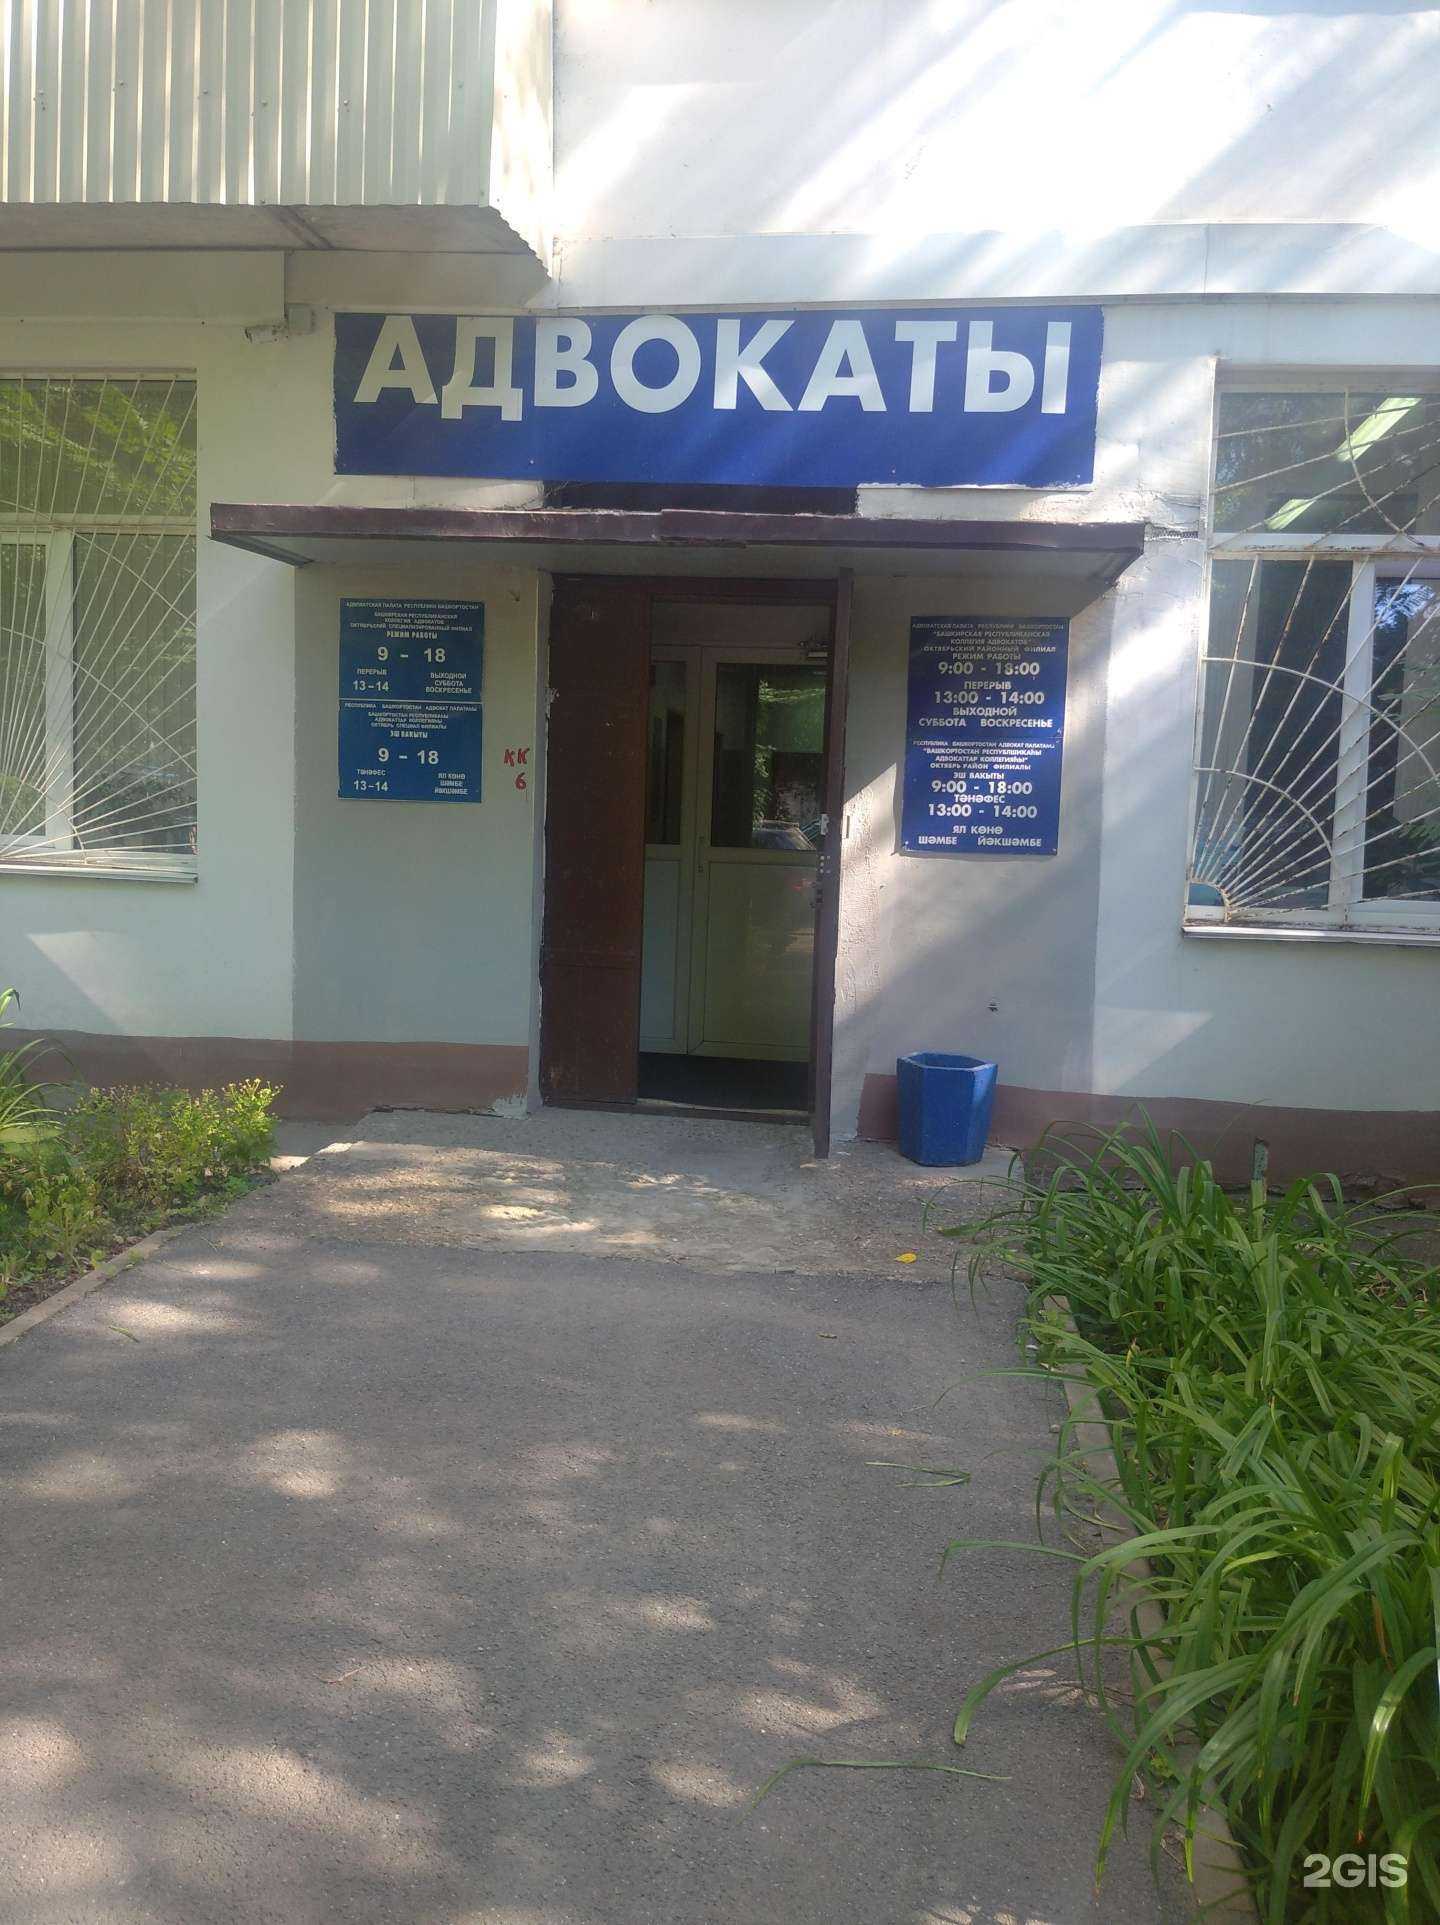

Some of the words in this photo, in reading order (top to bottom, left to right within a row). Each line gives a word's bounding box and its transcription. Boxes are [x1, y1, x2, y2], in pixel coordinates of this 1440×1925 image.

[352, 314, 1072, 421] АДВОКАТЫ
[377, 646, 389, 661] 9
[424, 648, 446, 662] 18
[938, 661, 973, 675] 9:00
[996, 663, 1040, 675] 18:00
[426, 686, 472, 694] ВОСКРЕСЕНЬЕ
[964, 682, 1012, 690] ПЕРЕРЫВ
[935, 691, 978, 704] 13:00
[1001, 692, 1044, 704] 14:00
[953, 706, 1017, 716] ВЫХОДНОЙ
[919, 718, 966, 727] СУББОТА
[980, 719, 1053, 728] ВОСКРЕСЕНЬЕ
[378, 747, 389, 762] 9
[417, 750, 439, 765] 18
[515, 772, 527, 790] 6
[931, 780, 966, 792] 9:00
[989, 782, 1032, 794] 18:00
[954, 795, 1005, 803] ТӘНӘФЕС
[929, 804, 971, 816] 13:00
[994, 805, 1037, 818] 14:00
[952, 825, 966, 834] ЯЛ
[919, 836, 958, 845] ШӘМБЕ
[978, 837, 1042, 846] ЙӘКШӘМБЕ
